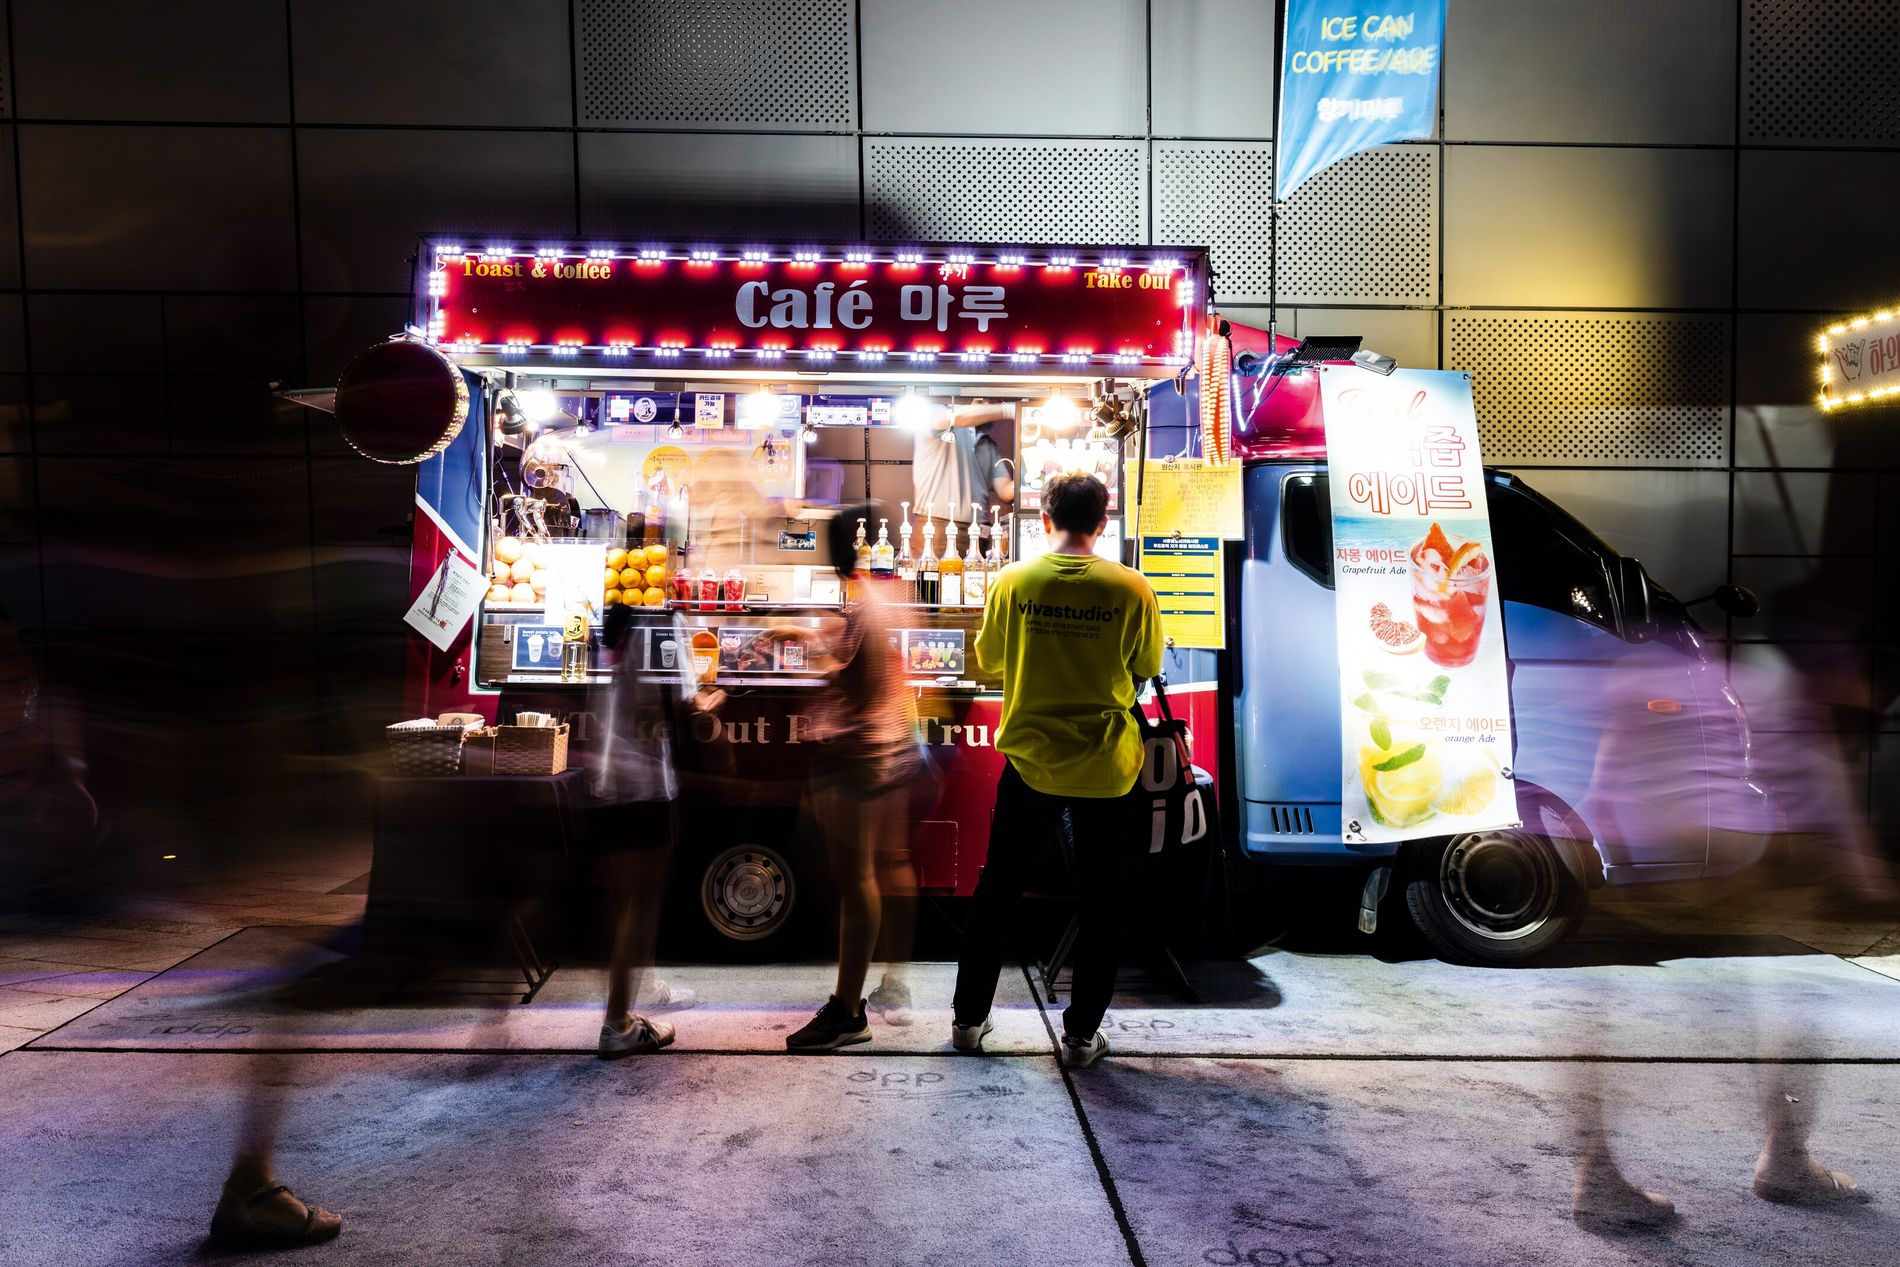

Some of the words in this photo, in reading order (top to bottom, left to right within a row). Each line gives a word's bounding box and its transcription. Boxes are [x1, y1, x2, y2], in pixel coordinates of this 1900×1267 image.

[1321, 16, 1358, 41] ICE
[1361, 12, 1415, 42] CAN
[462, 258, 523, 278] Toast
[531, 262, 547, 279] &
[553, 262, 611, 280] Coffee
[1084, 271, 1133, 290] Take
[1139, 271, 1172, 290] Out
[735, 279, 873, 331] Café
[899, 283, 1009, 333] 마루
[1349, 471, 1472, 516] 에이드
[1336, 548, 1362, 563] 자몽
[1365, 548, 1407, 563] 에이드
[1342, 564, 1386, 575] Grapefruit
[1389, 565, 1407, 575] Ade
[692, 711, 771, 744] Out
[1419, 716, 1461, 732] 오렌지
[1466, 716, 1509, 732] 에이드
[1478, 733, 1496, 743] Ade
